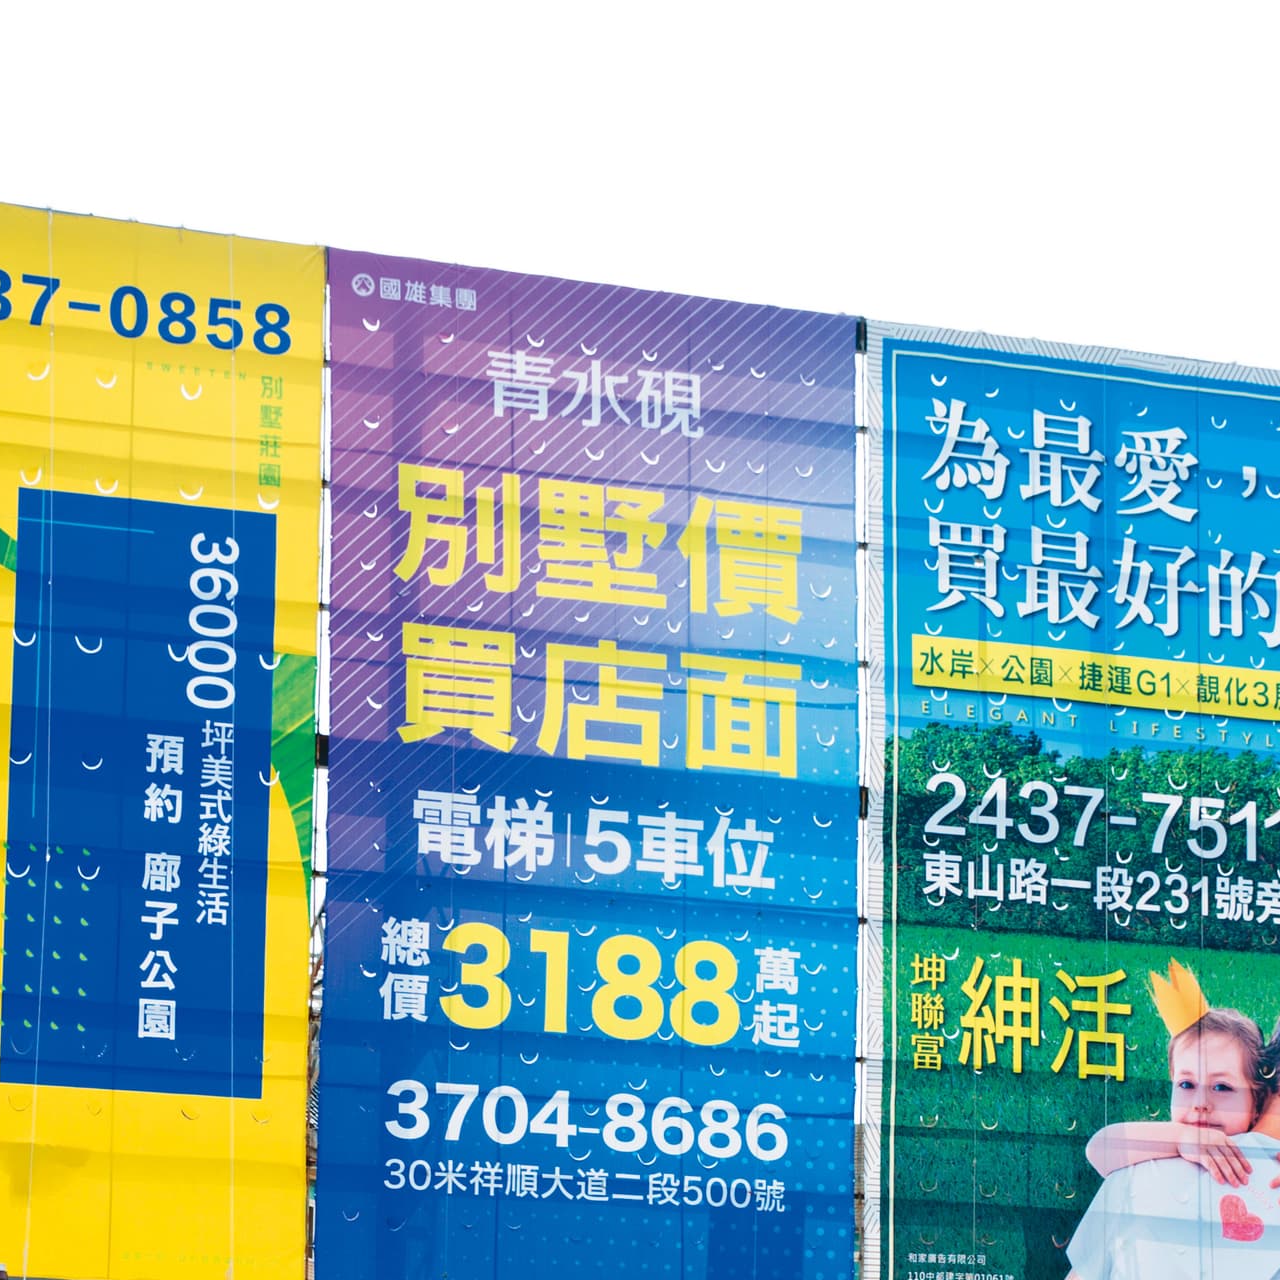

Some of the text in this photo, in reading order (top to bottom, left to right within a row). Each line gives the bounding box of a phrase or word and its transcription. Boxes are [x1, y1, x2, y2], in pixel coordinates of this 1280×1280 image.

[379, 277, 477, 311] 國雄集團
[258, 375, 284, 488] 別墅莊園
[393, 462, 804, 626] 別墅價
[396, 622, 803, 780] 買店面
[921, 700, 1078, 728] ELEGANT
[143, 734, 185, 824] 預約
[413, 789, 777, 892] 電梯 5車位
[379, 916, 431, 1023] 總價
[439, 922, 741, 1047] 3188
[752, 946, 801, 1049] 萬起
[910, 953, 946, 1072] 坤聯富
[958, 957, 1132, 1082] 紳活
[384, 1079, 789, 1162] 3704-8686
[384, 1158, 787, 1213] 30米祥順大道二段500號
